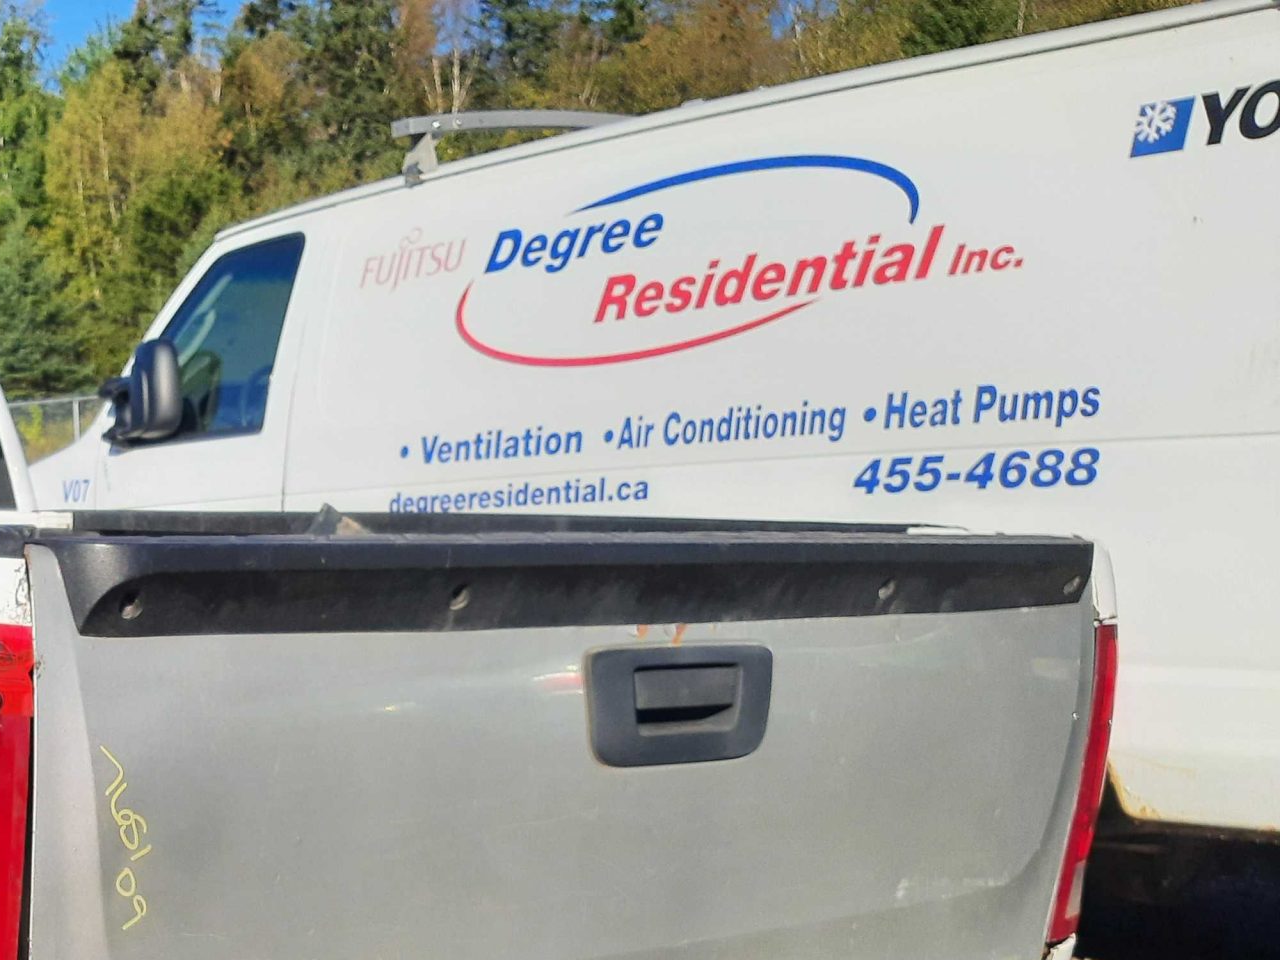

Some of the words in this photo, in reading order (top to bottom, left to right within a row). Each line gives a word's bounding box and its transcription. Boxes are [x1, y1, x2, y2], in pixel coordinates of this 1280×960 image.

[1201, 79, 1280, 146] YO
[361, 227, 466, 292] FUJITSU
[484, 213, 664, 274] Degree
[594, 225, 945, 323] Residential
[948, 243, 1024, 276] Inc.
[421, 425, 583, 464] Ventilation
[617, 415, 655, 450] Air
[663, 400, 847, 442] Conditioning
[883, 392, 963, 430] Heat
[973, 385, 1101, 427] Pumps
[62, 478, 91, 503] V07
[389, 476, 650, 513] degreeresidential.ca
[853, 448, 1101, 495] 455-4688
